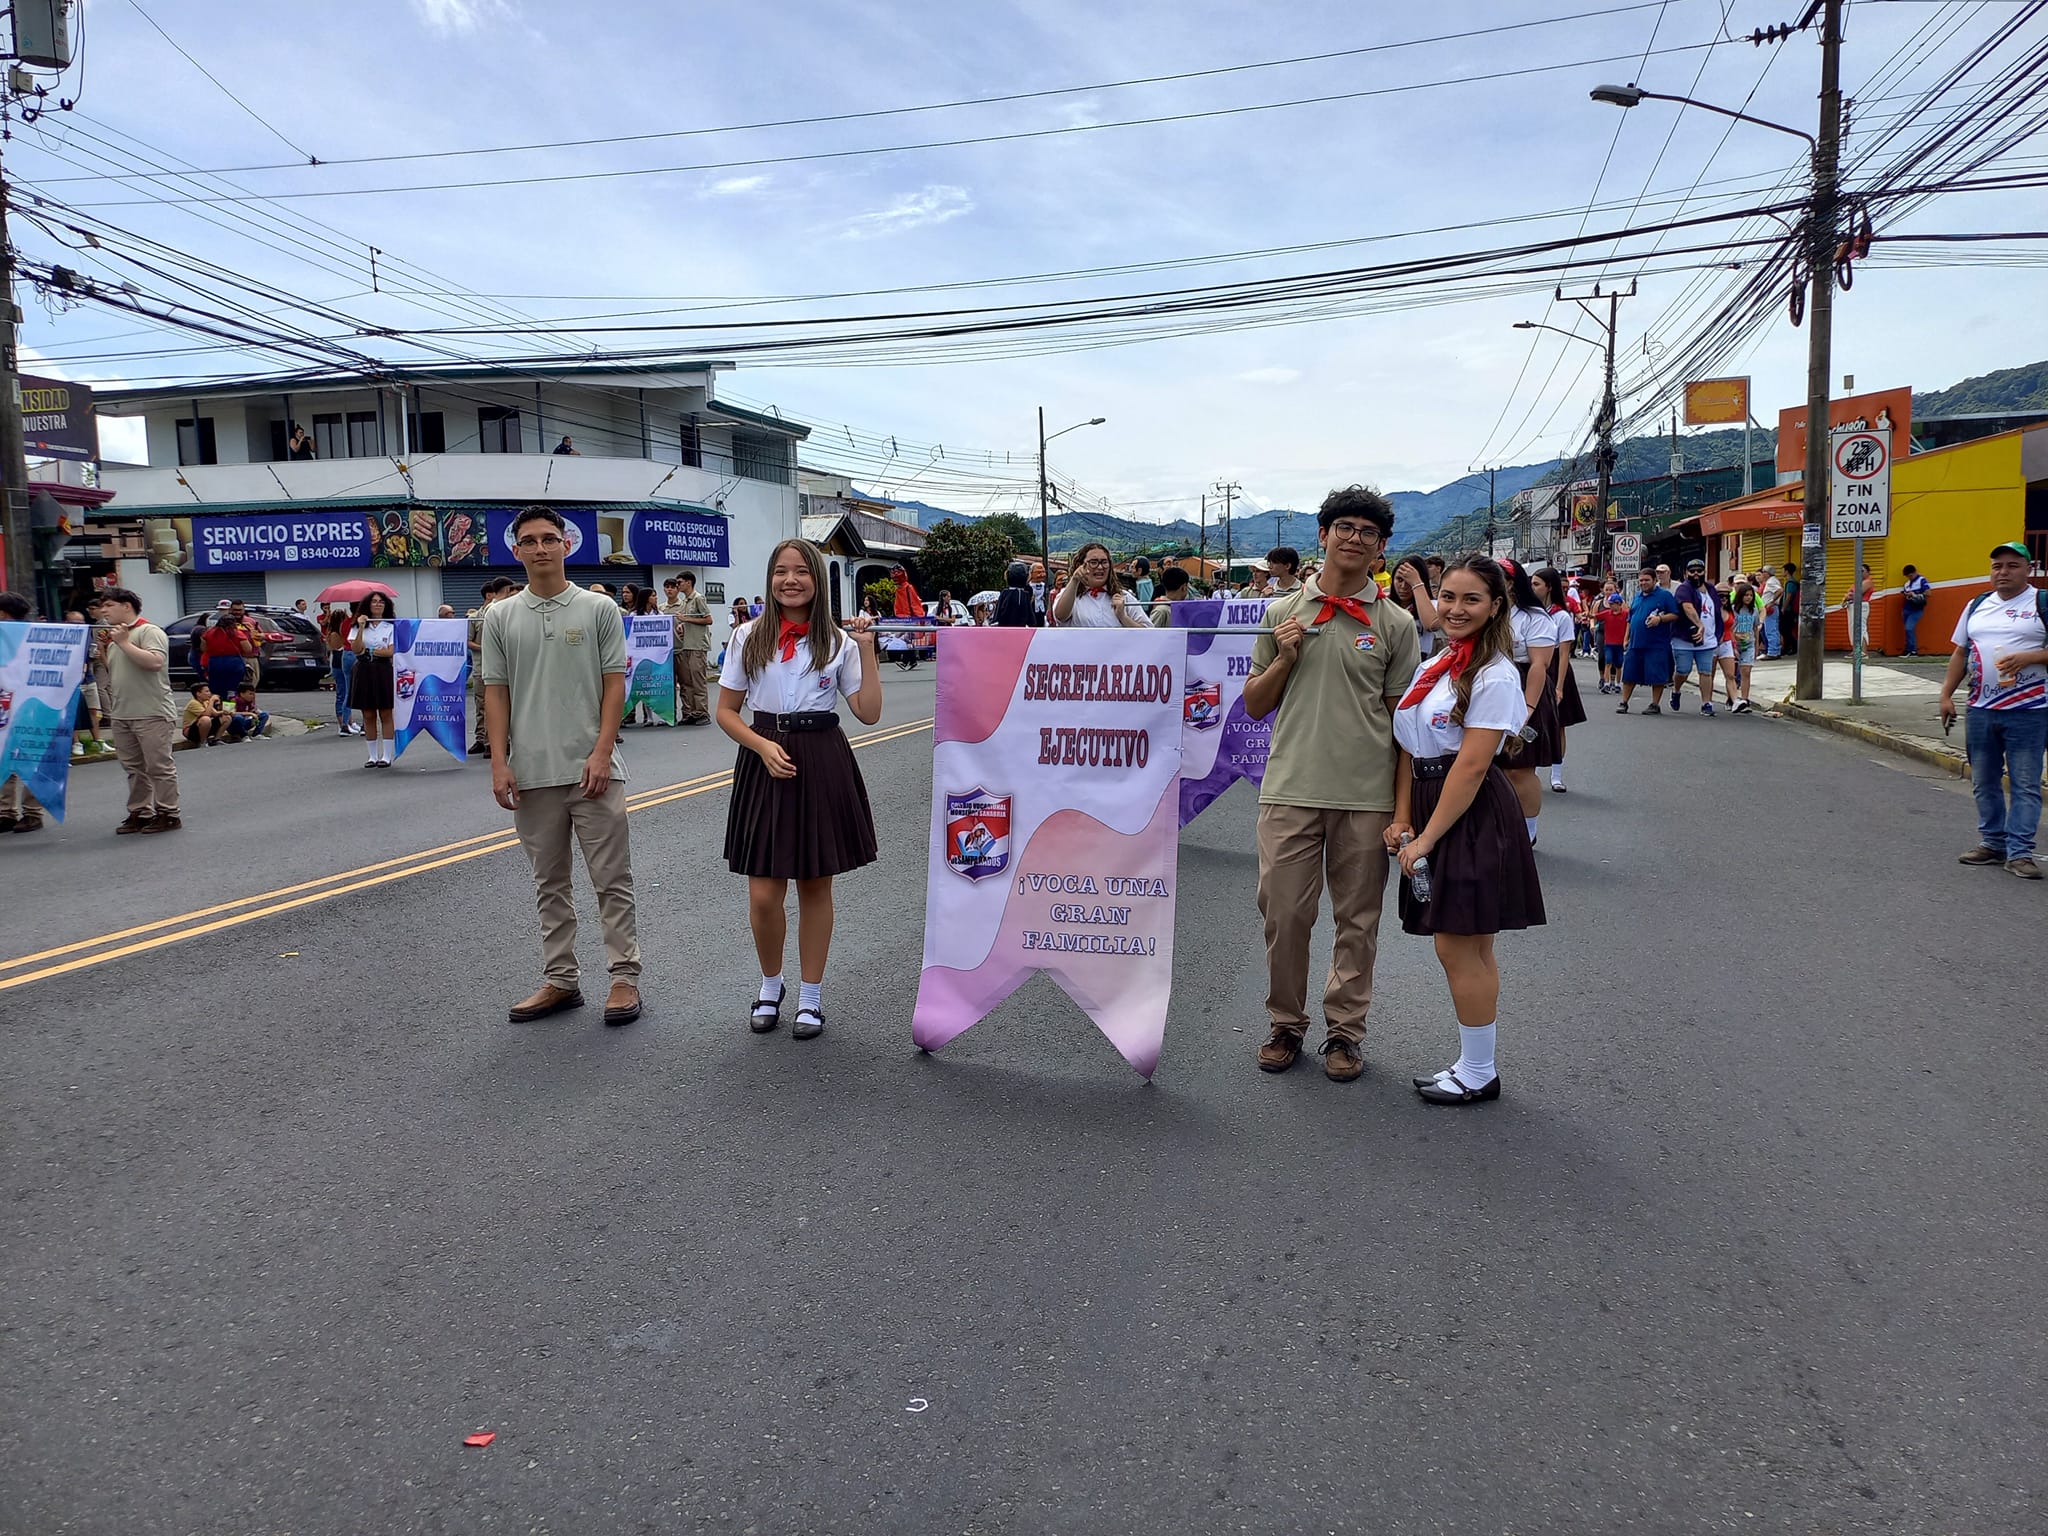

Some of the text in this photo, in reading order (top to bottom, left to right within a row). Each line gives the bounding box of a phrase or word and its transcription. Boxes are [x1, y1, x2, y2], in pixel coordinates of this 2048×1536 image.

[21, 389, 69, 411] NSIDAD
[22, 415, 67, 432] NUESTRA
[1851, 441, 1870, 456] 25
[1846, 457, 1874, 472] KPH
[1847, 484, 1872, 497] FIN
[1837, 502, 1881, 516] ZONA
[203, 521, 364, 546] SERVICIO EXPRES
[645, 519, 725, 537] PRECIOS ESPECIALES
[1836, 519, 1881, 534] ESCOLAR
[667, 534, 716, 549] PARA SODAS Y
[1620, 538, 1634, 548] 40
[223, 546, 361, 562] 4081-1794 8340-0228
[664, 548, 719, 563] RESTAURANTES
[1024, 664, 1172, 704] SECRETARIADO
[1038, 728, 1149, 769] EJECUTIVO
[1018, 873, 1169, 897] ¡VOCA UNA
[1050, 904, 1131, 925] GRAN
[1022, 930, 1156, 955] FAMILIA!
